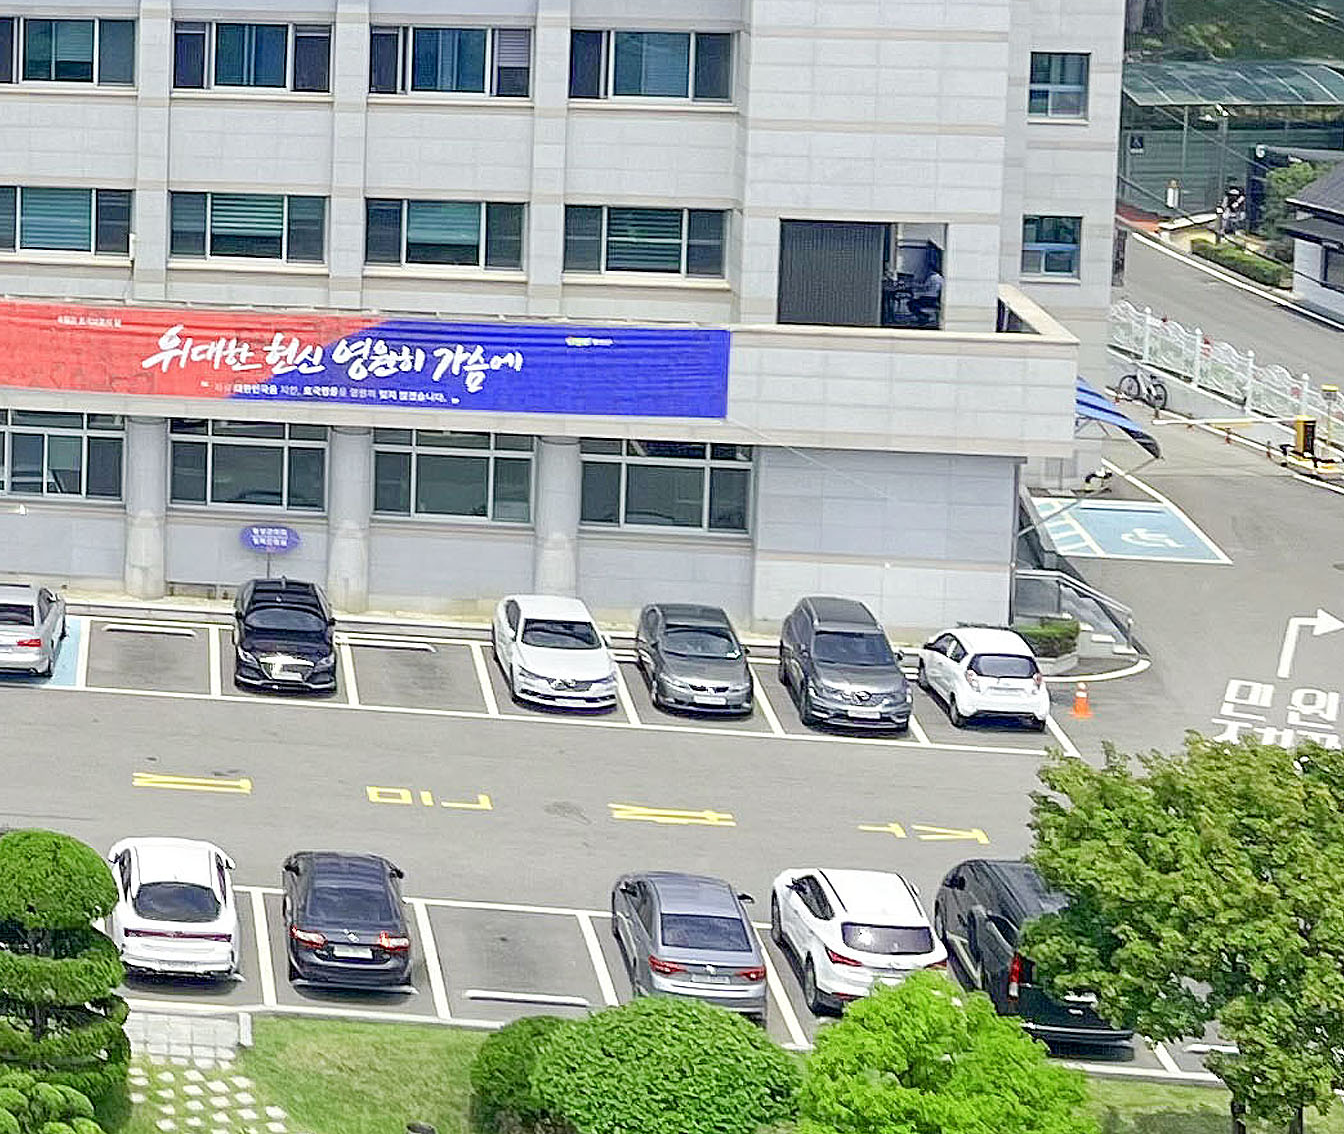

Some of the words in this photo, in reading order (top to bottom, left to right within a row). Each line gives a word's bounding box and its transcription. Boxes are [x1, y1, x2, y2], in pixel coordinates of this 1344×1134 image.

[141, 324, 262, 372] 위대한
[262, 331, 326, 376] 헌신
[332, 338, 425, 382] 영원히
[432, 344, 524, 393] 가슴에
